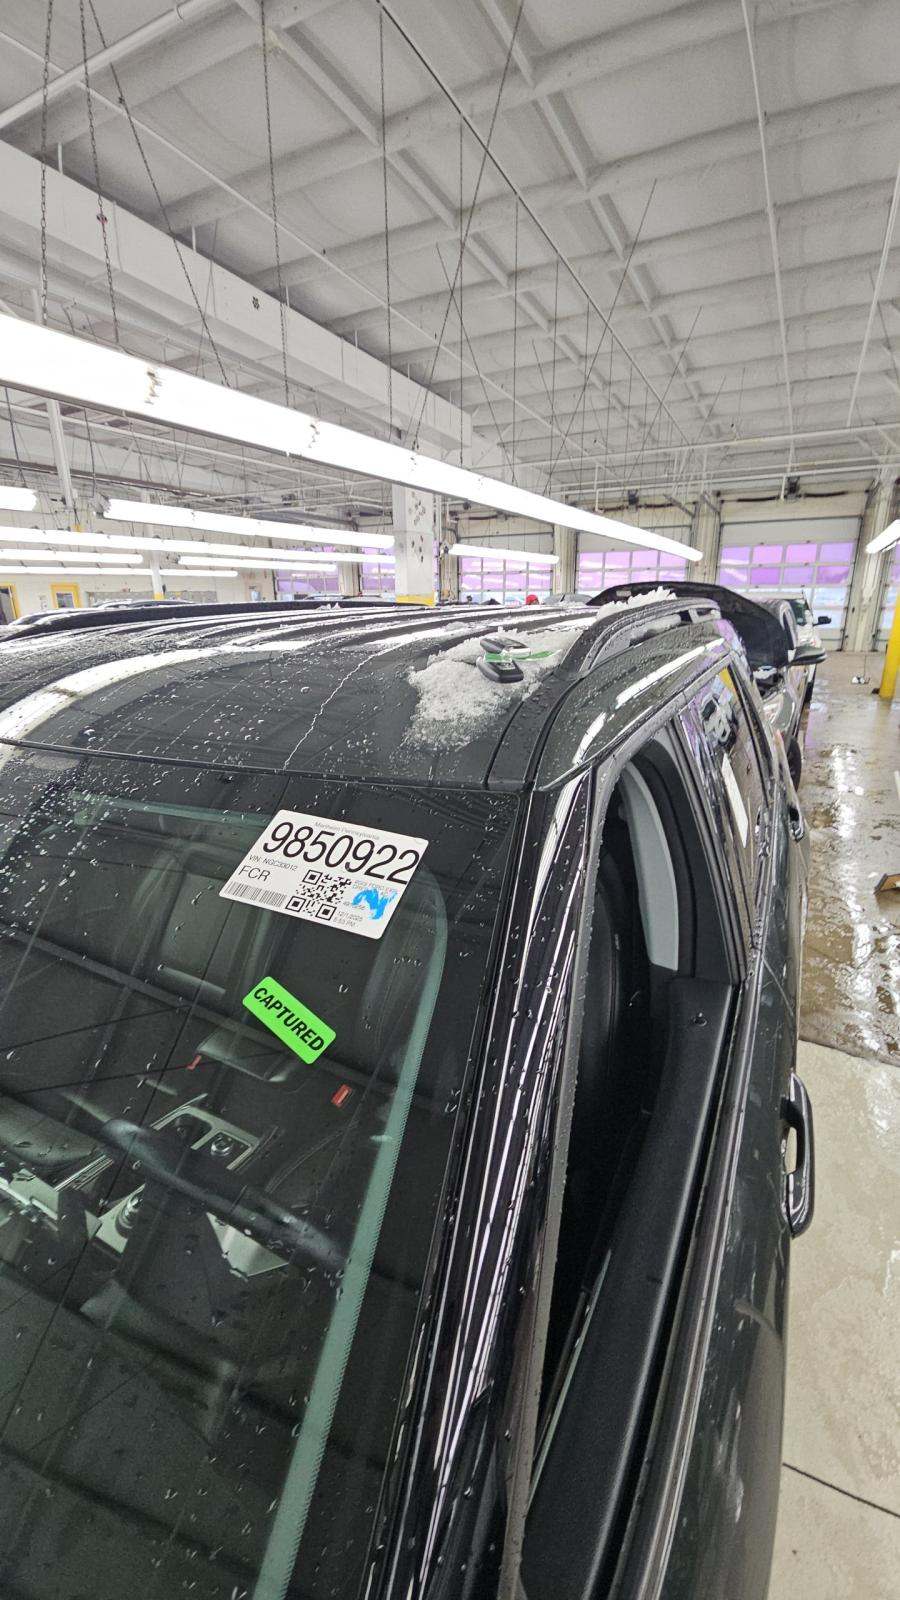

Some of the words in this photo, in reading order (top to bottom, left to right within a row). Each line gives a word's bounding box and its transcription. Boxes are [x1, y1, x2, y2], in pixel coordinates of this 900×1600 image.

[238, 865, 271, 882] FCR
[263, 821, 420, 885] 9850922
[253, 987, 325, 1051] CAPTURED
